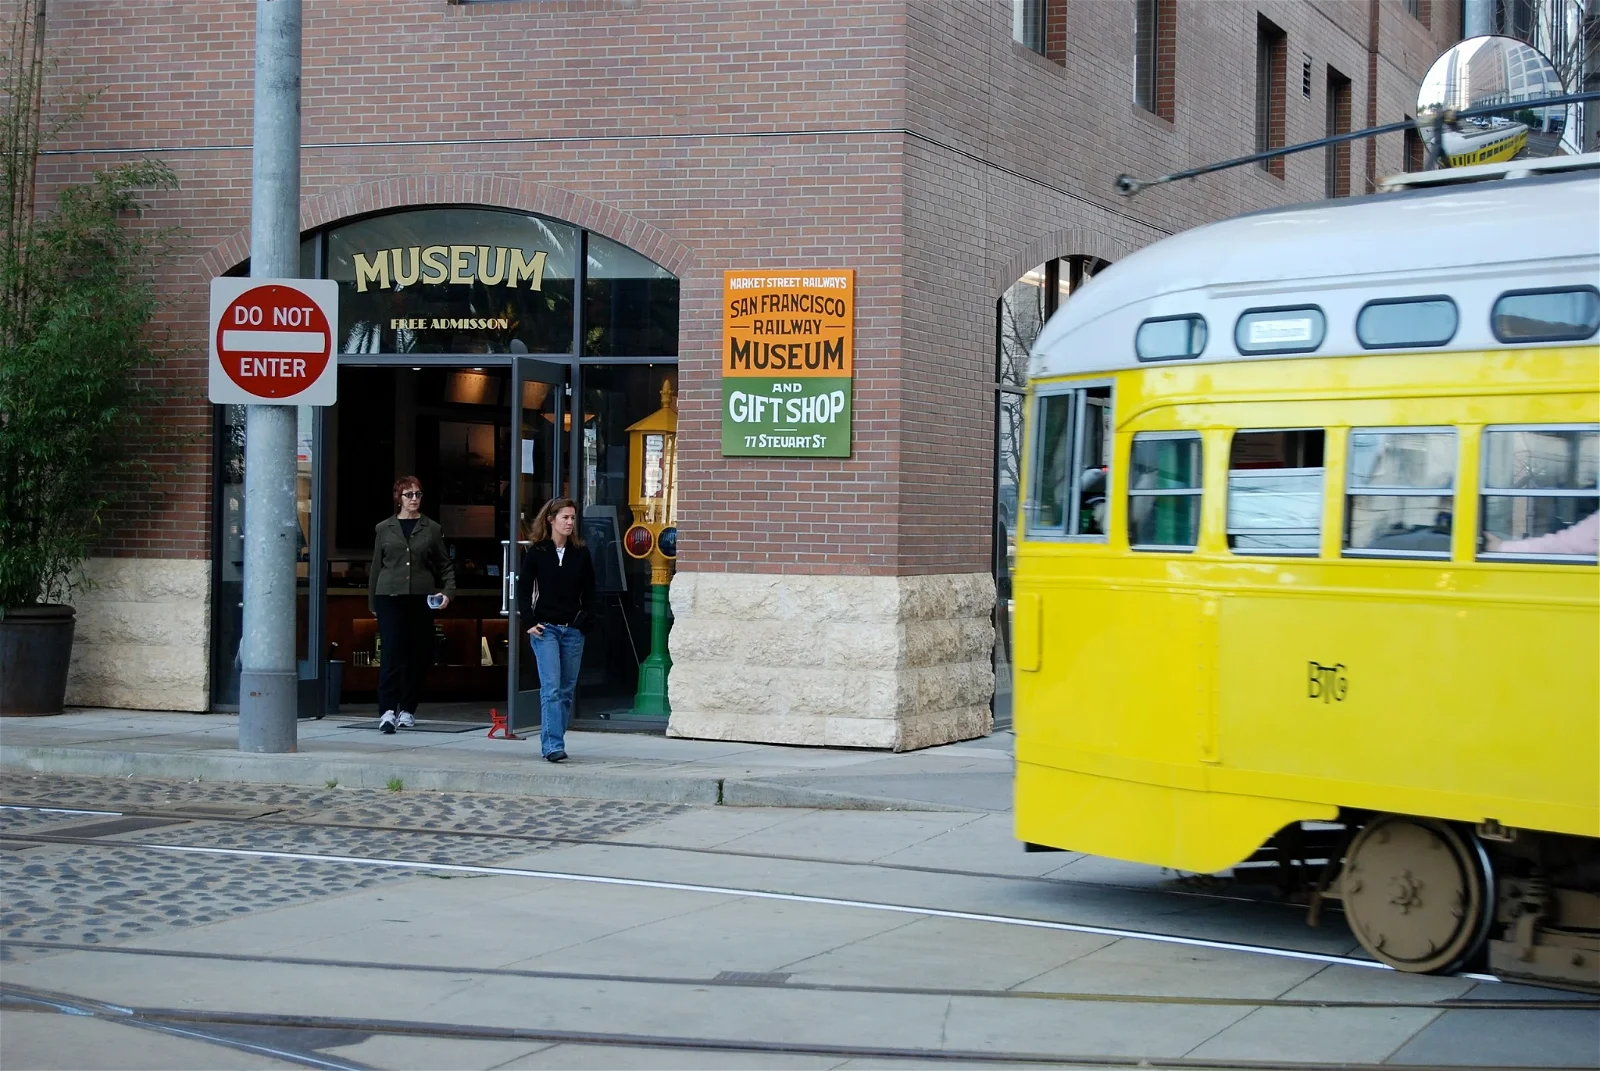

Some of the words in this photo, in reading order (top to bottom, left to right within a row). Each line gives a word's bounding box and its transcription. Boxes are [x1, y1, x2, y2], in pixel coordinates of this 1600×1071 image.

[353, 245, 548, 292] MUSEUM
[730, 277, 766, 289] MARKET
[767, 277, 801, 288] STREET
[730, 296, 758, 318] SAN
[761, 294, 845, 318] FRANCISCO
[235, 306, 263, 325] DO
[273, 307, 314, 327] NOT
[390, 318, 428, 330] FREE
[430, 318, 508, 330] ADMISSON
[753, 319, 822, 334] RAILWAY
[730, 336, 844, 370] MUSEUM
[240, 357, 306, 377] ENTER
[772, 383, 802, 392] AND
[729, 390, 783, 423] GIFT
[786, 390, 845, 424] SHOP
[744, 435, 757, 448] 77
[759, 433, 811, 448] STEUART
[812, 434, 827, 448] ST
